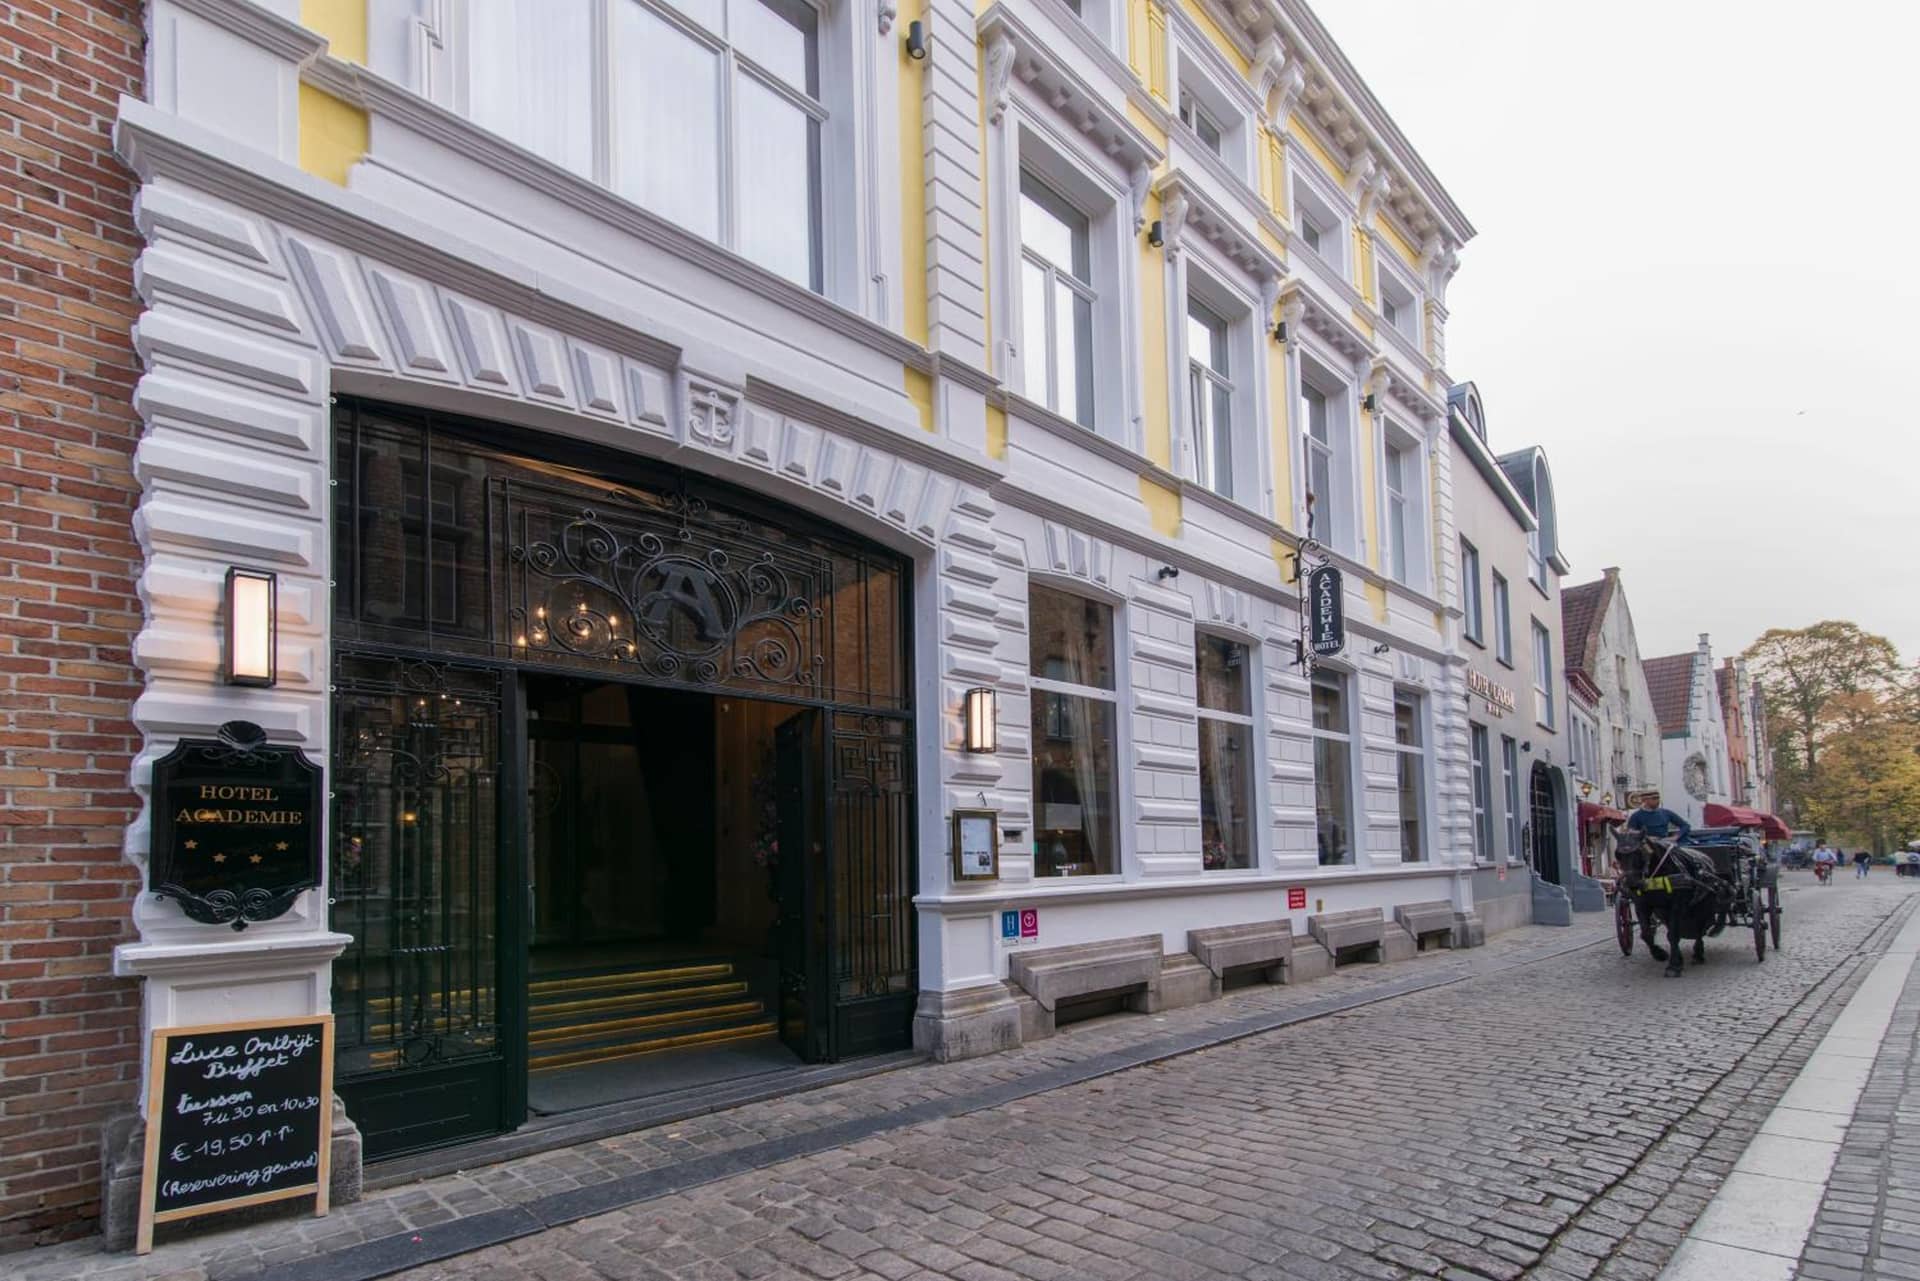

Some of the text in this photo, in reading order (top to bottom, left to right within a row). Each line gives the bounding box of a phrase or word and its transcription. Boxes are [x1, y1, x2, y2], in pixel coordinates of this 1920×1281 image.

[1319, 572, 1333, 641] ACADEMIE
[200, 784, 279, 801] HOTEL
[176, 808, 303, 824] ACADEMIE
[170, 1042, 239, 1064] Luxe
[202, 1053, 289, 1080] Buffet
[177, 1090, 253, 1114] tussen
[257, 1103, 279, 1115] en
[170, 1142, 192, 1162] €
